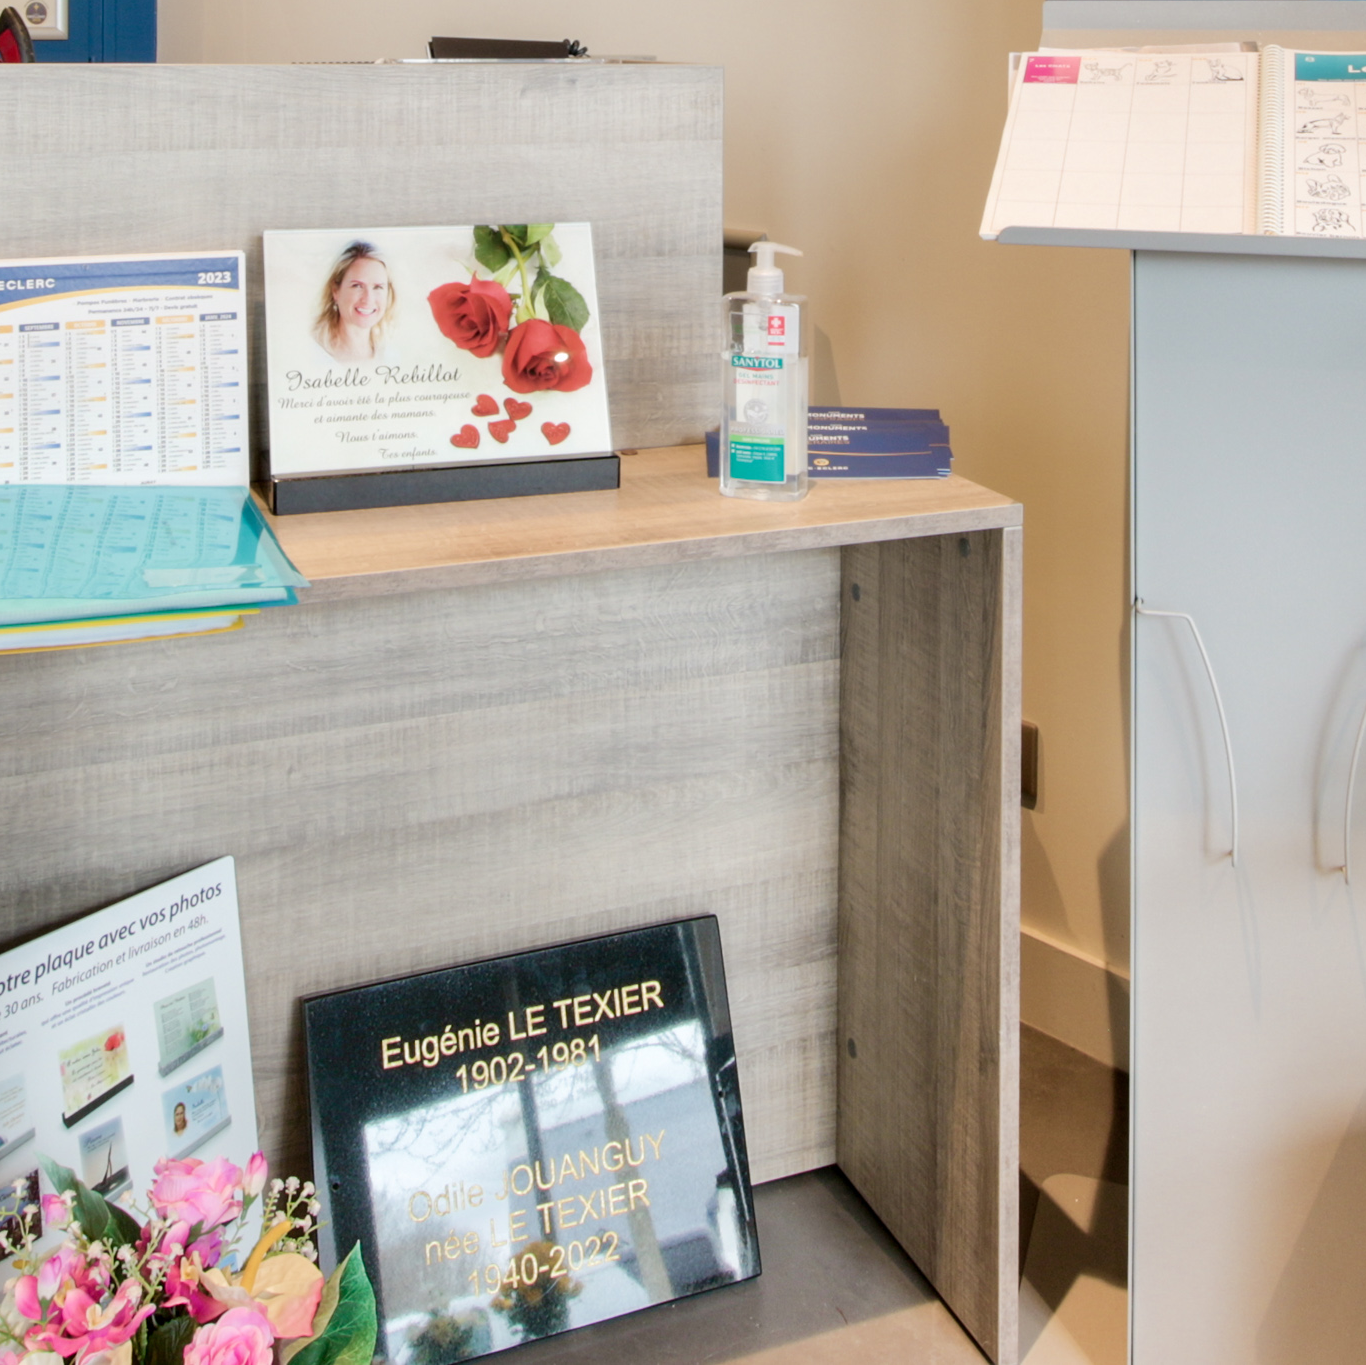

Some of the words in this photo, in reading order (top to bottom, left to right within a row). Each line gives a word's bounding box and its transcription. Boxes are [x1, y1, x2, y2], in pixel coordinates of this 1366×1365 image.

[198, 272, 232, 285] 2023
[286, 368, 370, 391] Isabelle
[375, 363, 461, 385] Rebillot
[733, 357, 780, 368] SANYTOL
[278, 397, 313, 409] Merci
[317, 394, 353, 407] d'avoir
[357, 395, 371, 405] été
[375, 393, 385, 403] la
[388, 392, 411, 406] plus
[415, 392, 471, 405] courageuse
[314, 415, 323, 424] et
[327, 412, 368, 423] aimante
[371, 410, 388, 420] des
[391, 411, 436, 419] mamans.
[336, 431, 369, 443] Nous
[372, 429, 418, 440] t'aimons.
[378, 449, 399, 459] Tes
[402, 447, 437, 460] enfants.
[35, 940, 95, 984] plaque
[99, 921, 136, 950] avec
[139, 908, 165, 930] vos
[169, 882, 222, 922] photos
[5, 1002, 18, 1018] 30
[21, 993, 44, 1011] ans.
[51, 957, 113, 996] Fabrication
[116, 953, 126, 965] et
[129, 933, 171, 960] livraison
[174, 925, 186, 939] en
[188, 915, 208, 931] 48h.
[381, 1017, 500, 1070] Eugénie
[509, 1005, 546, 1041] LE
[553, 981, 664, 1030] TEXIER
[455, 1035, 602, 1094] 1902-1981
[407, 1182, 484, 1223] Odile
[495, 1130, 666, 1201] JOUANGUY
[425, 1229, 479, 1266] née
[490, 1210, 528, 1248] LE
[536, 1178, 651, 1233] TEXIER
[469, 1232, 621, 1297] 1940-2022
